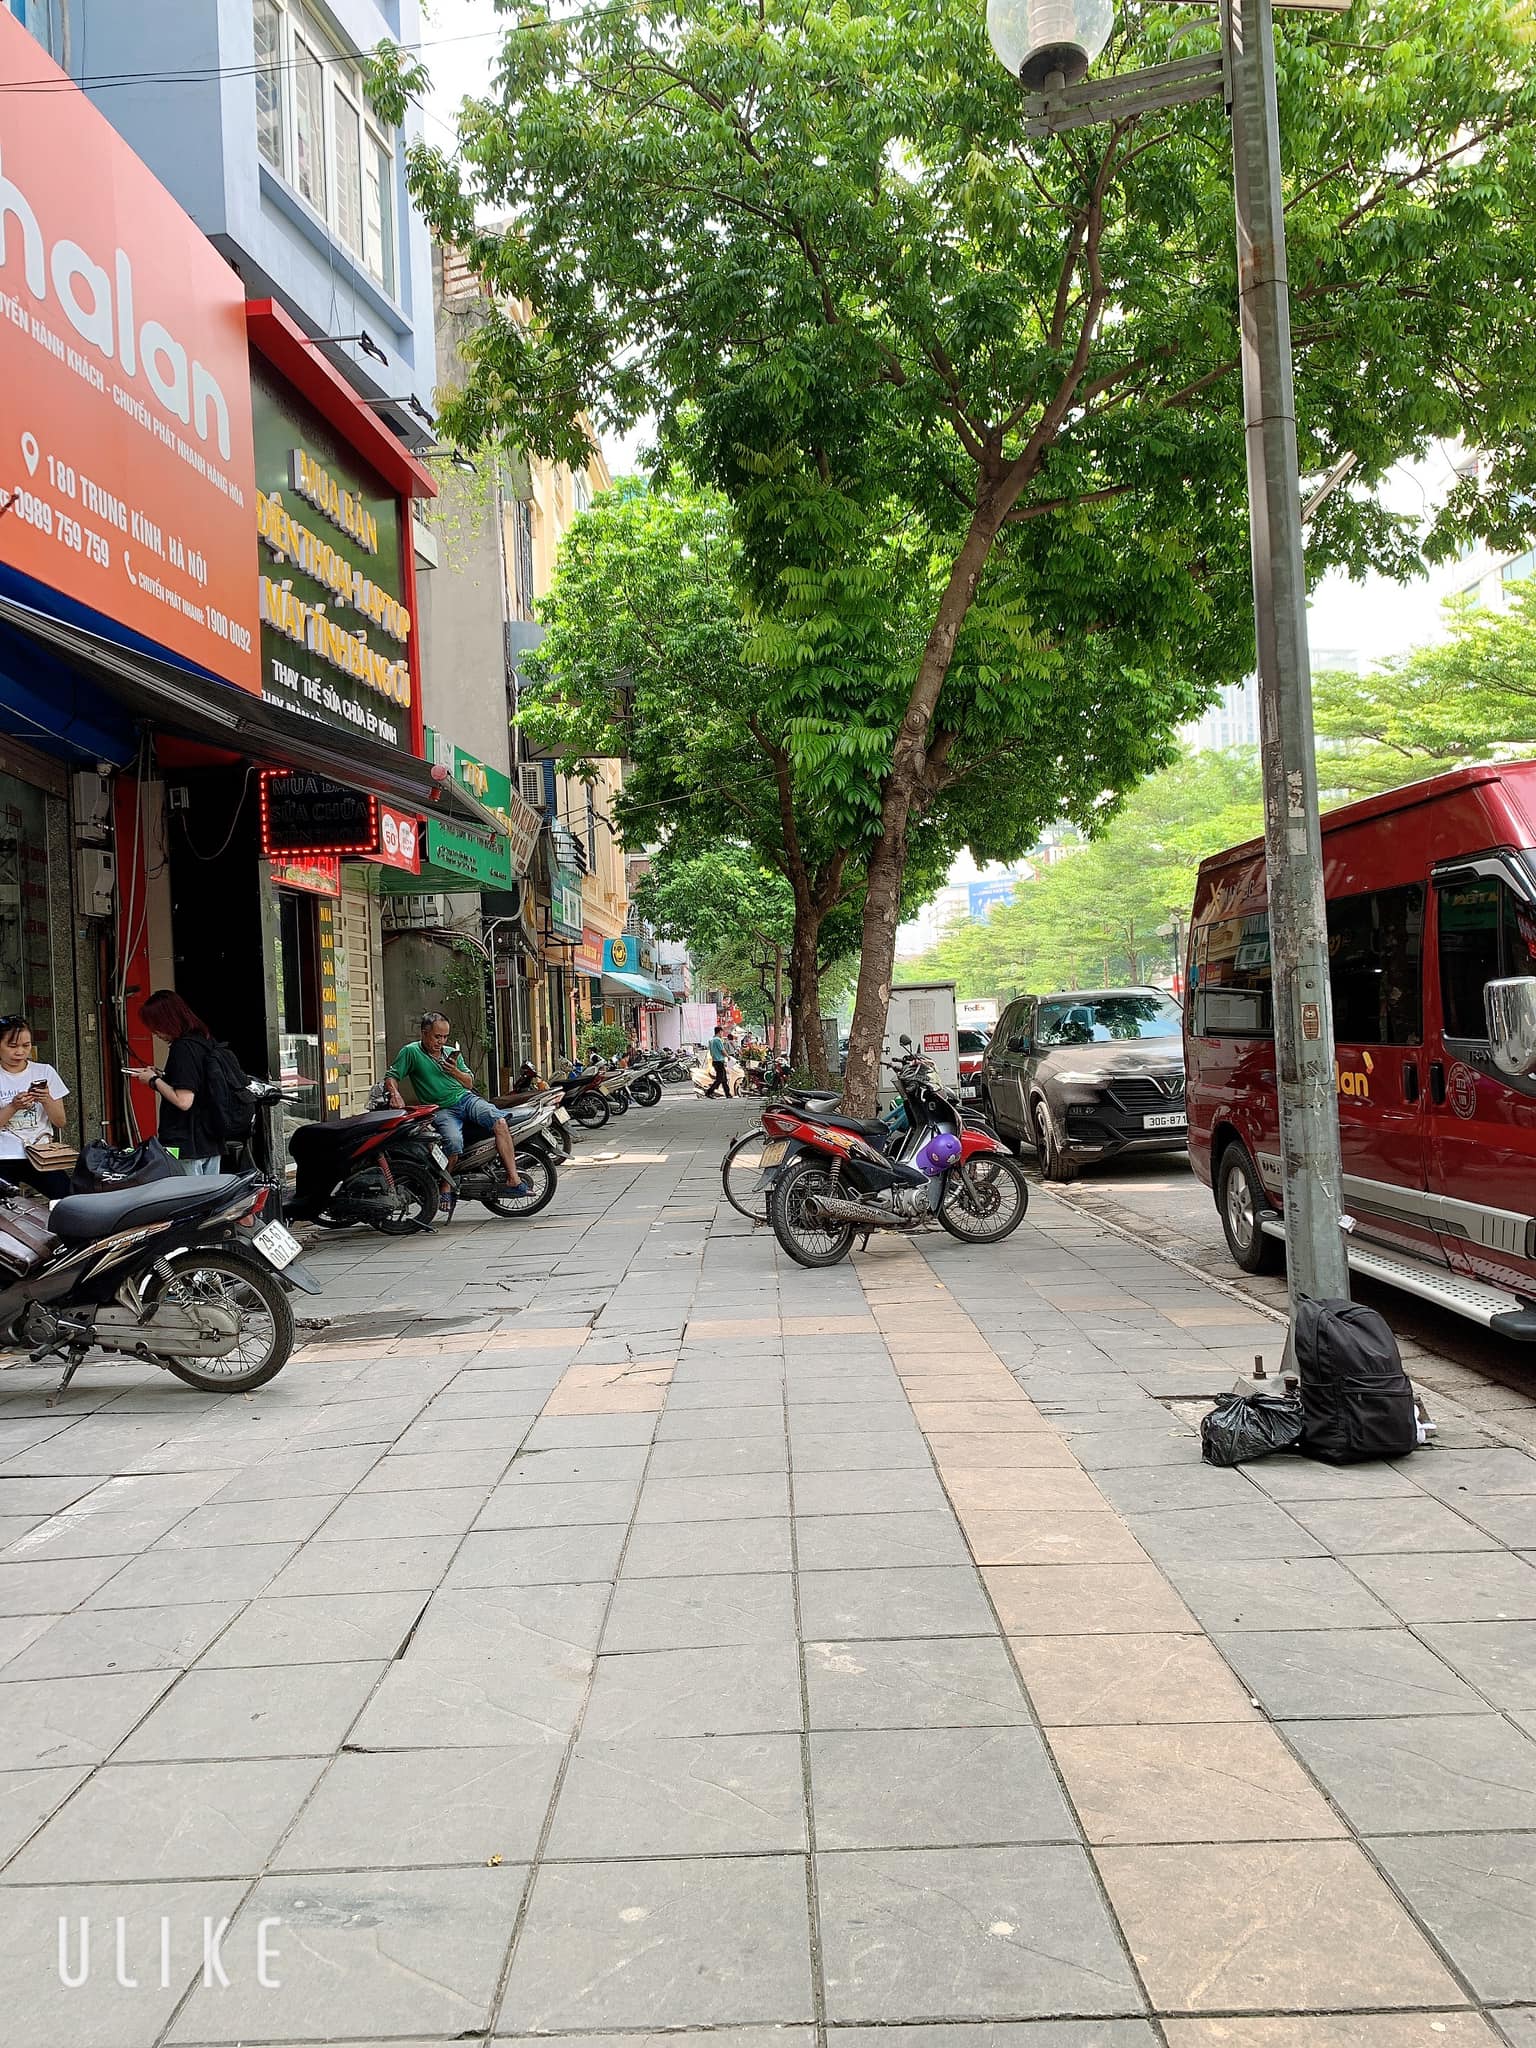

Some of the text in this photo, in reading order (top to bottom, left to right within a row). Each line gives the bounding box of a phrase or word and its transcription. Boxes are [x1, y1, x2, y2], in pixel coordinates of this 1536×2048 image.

[31, 317, 65, 362] HÀNH
[66, 345, 104, 393] KHÁCH
[113, 386, 152, 431] CHUYỂN
[153, 418, 175, 451] PHÁT
[177, 438, 206, 476] NHANH
[207, 464, 228, 497] HÀNG
[14, 485, 52, 535] 0989
[55, 510, 82, 553] 759
[84, 527, 110, 569] 759
[47, 454, 208, 588] 180 TRUNG KÍNH, HÀ NỘI
[293, 448, 378, 555] MUA BÁN
[138, 572, 165, 602] CHUYỂN
[165, 588, 182, 612] PHÁT
[205, 604, 229, 640] 1900
[229, 620, 251, 654] 0092
[259, 576, 411, 708] MÁY TÍNH BẢNG CŨ
[272, 659, 299, 692] THAY
[301, 677, 322, 705] THẾ
[322, 685, 343, 716] SỬA
[342, 699, 366, 729] CHỮA
[367, 707, 378, 733] ÉP
[378, 717, 398, 746] KÍNH
[272, 777, 319, 796] MUA
[312, 797, 368, 821] CHỮA
[320, 907, 332, 922] MUA
[964, 1004, 985, 1012] FedEx
[325, 1067, 339, 1084] LAP
[327, 1094, 340, 1111] TOP
